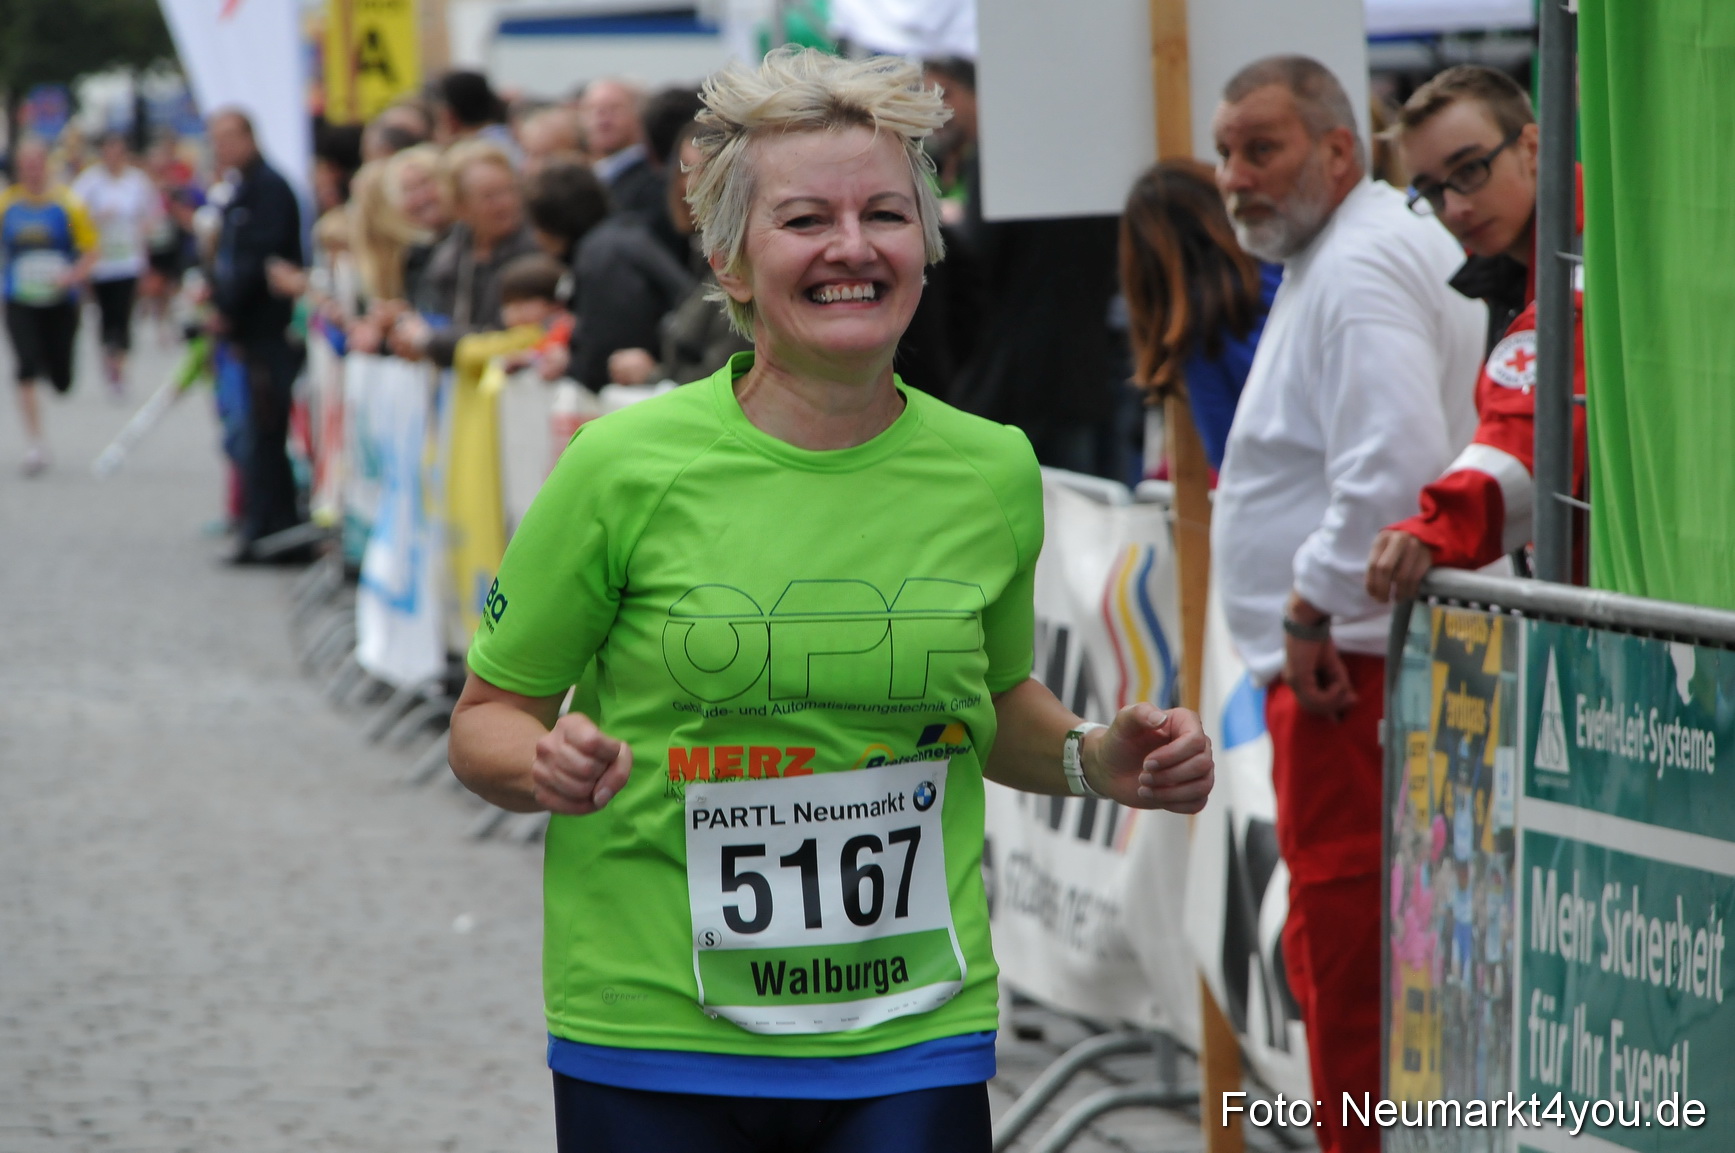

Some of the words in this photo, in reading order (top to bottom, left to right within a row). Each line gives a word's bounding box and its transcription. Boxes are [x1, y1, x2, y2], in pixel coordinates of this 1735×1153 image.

[738, 705, 767, 717] und
[771, 701, 946, 716] Automatisierungstechnik
[950, 694, 981, 713] GmbH
[668, 745, 815, 781] MERZ
[693, 805, 786, 830] PARTL
[794, 792, 905, 824] Neumarkt
[721, 825, 921, 934] 5167
[704, 931, 715, 947] S
[1531, 865, 1596, 965] Mehr
[1601, 882, 1725, 1004] Sicherheit
[750, 955, 910, 996] Walburga
[1528, 987, 1568, 1088] für
[1571, 1001, 1604, 1100] Ihr
